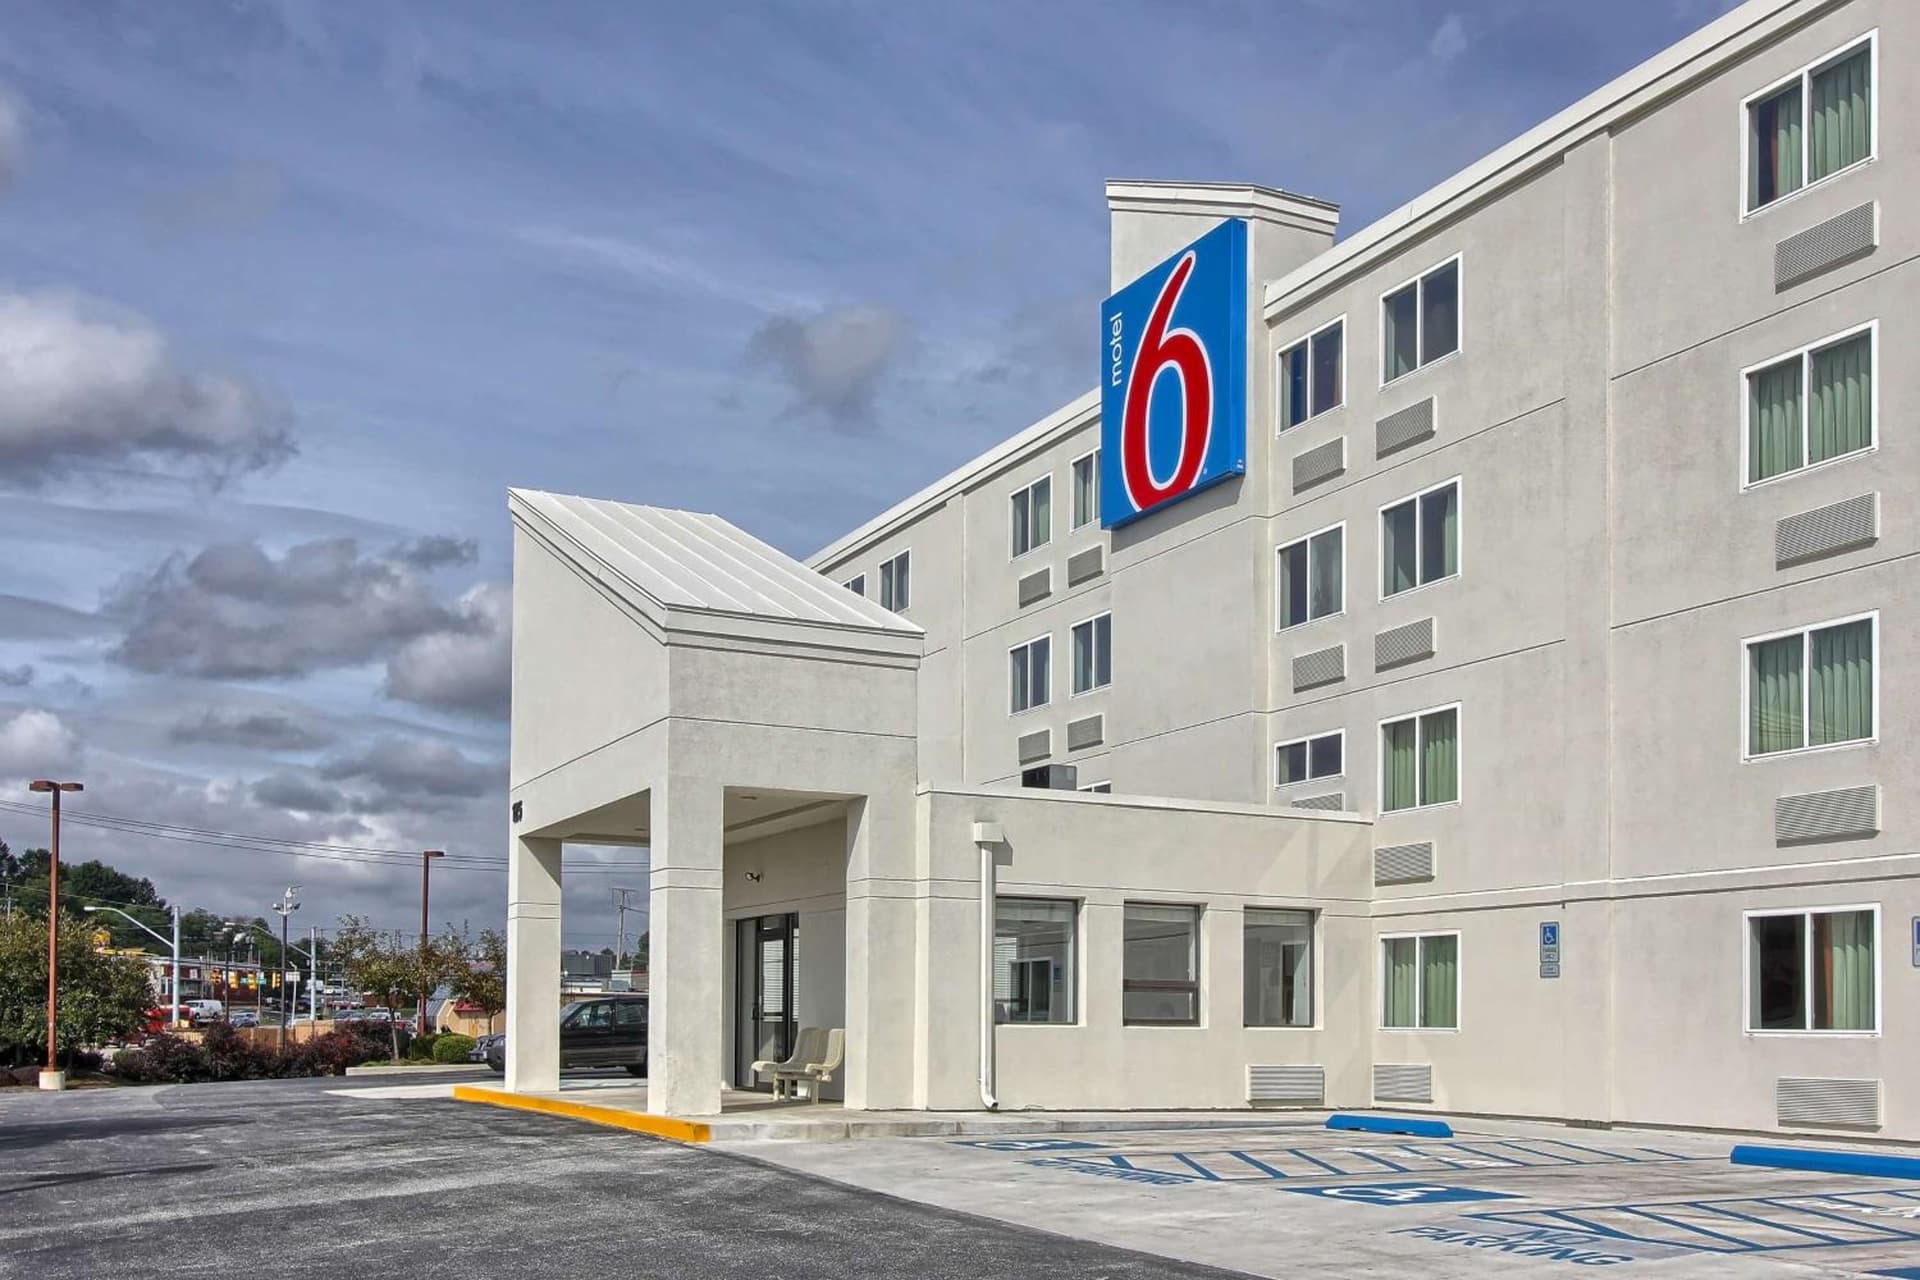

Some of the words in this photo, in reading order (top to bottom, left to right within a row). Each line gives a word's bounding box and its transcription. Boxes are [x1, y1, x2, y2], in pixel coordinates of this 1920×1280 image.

[1111, 311, 1123, 387] motel
[1121, 250, 1214, 512] 6
[1387, 1226, 1635, 1265] PARKING
[1503, 1229, 1601, 1245] NO
